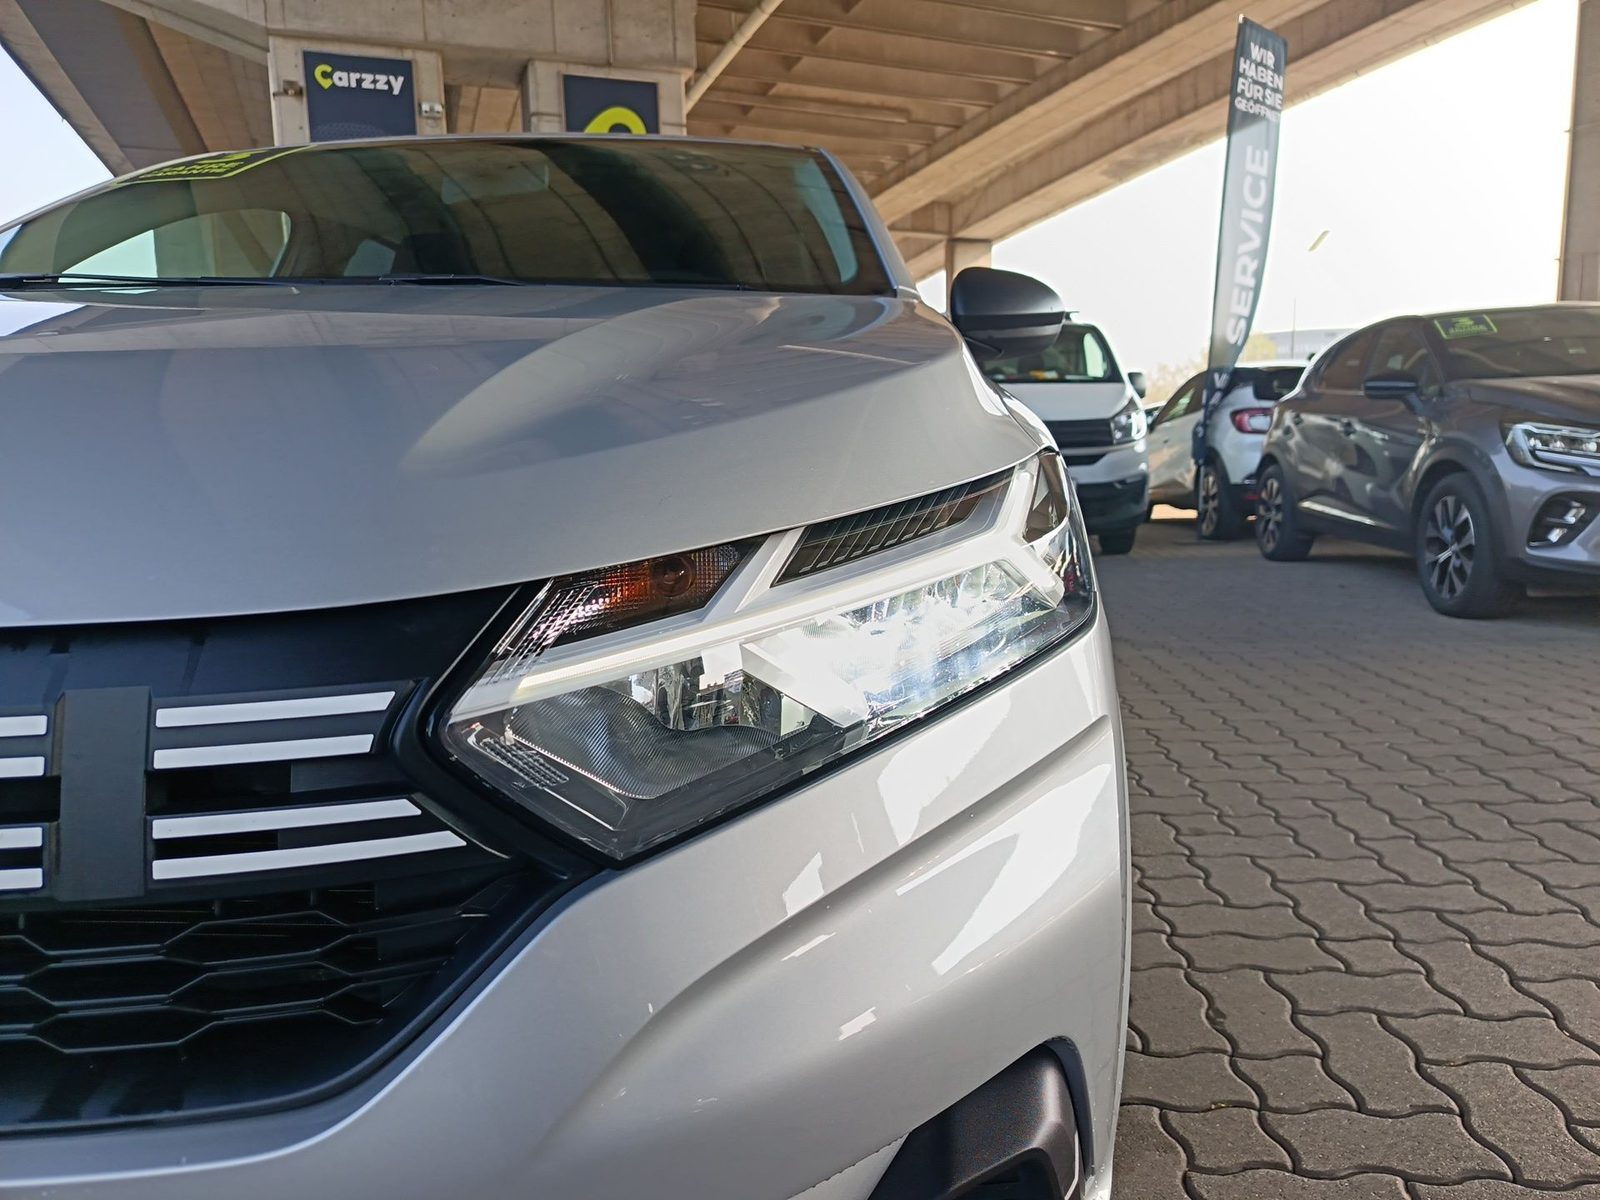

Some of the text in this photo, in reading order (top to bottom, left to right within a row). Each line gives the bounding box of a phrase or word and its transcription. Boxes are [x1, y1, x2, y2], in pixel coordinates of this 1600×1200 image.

[1250, 41, 1275, 70] WIR
[314, 63, 404, 95] Carzzy
[1239, 56, 1284, 91] HABEN
[1237, 76, 1283, 110] FÜR SIE
[1225, 145, 1269, 347] SERVICE
